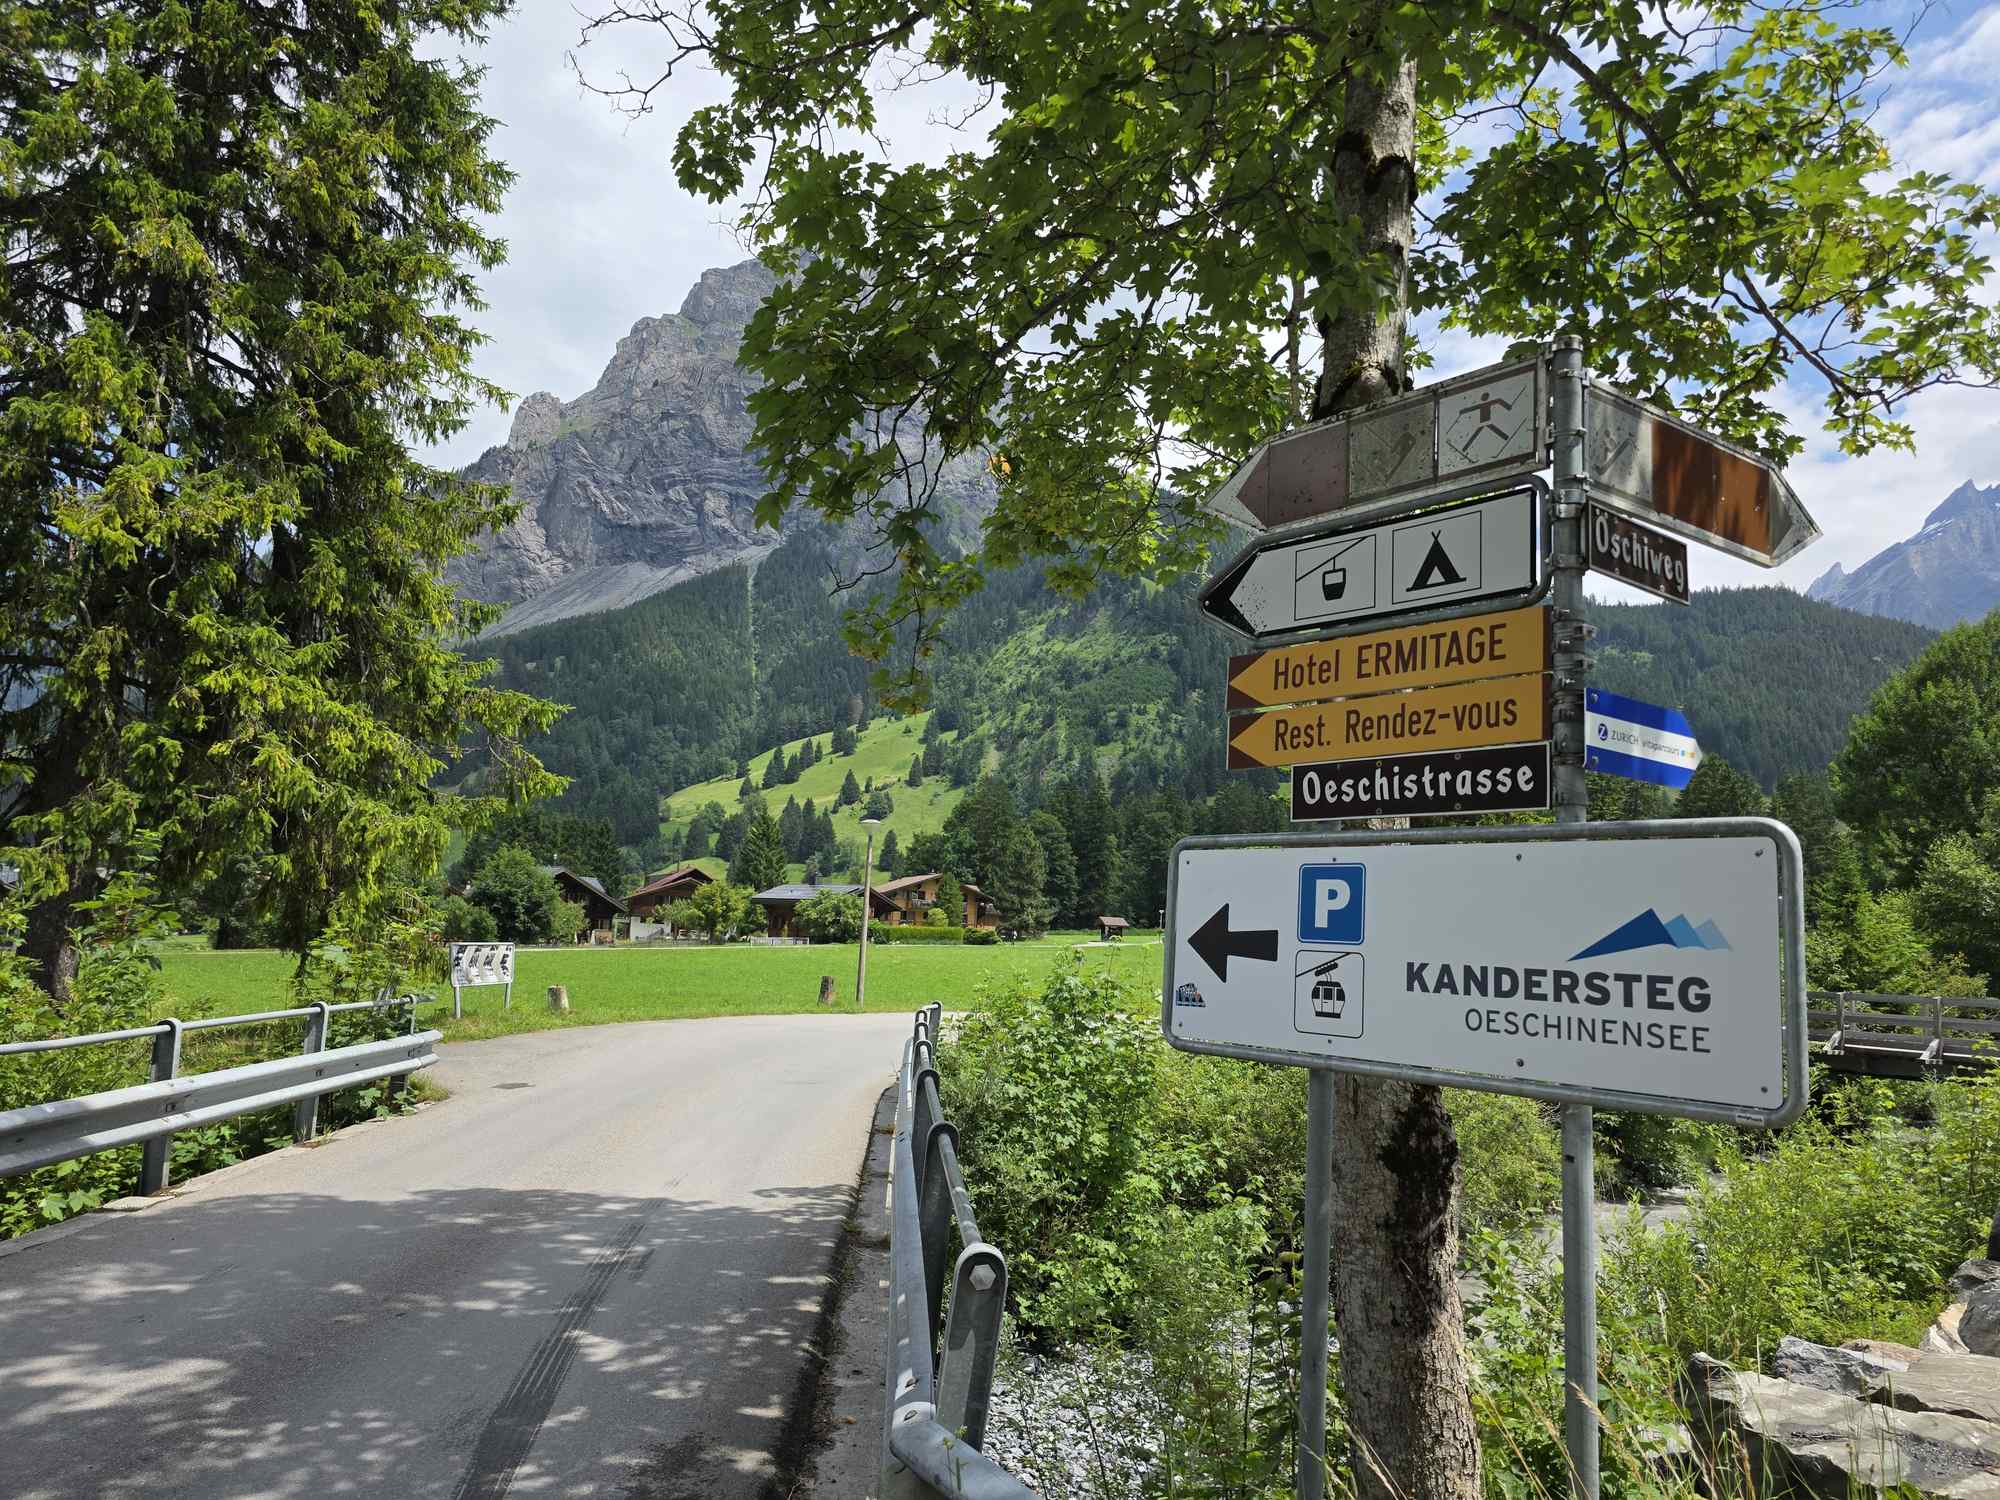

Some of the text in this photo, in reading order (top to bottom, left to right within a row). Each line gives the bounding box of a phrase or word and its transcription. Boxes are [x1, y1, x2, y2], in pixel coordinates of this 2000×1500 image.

[1595, 508, 1684, 593] Öschiweg
[1273, 623, 1507, 690] Hotel ERMITAGE
[1274, 698, 1518, 751] Rest. Rendez-vous
[1611, 729, 1640, 745] ZURICH
[1302, 764, 1535, 805] Oeschistrasse
[1315, 879, 1351, 929] P
[1406, 961, 1712, 1013] KANDERSTEG
[1465, 1008, 1711, 1053] OESCHINENSEE
